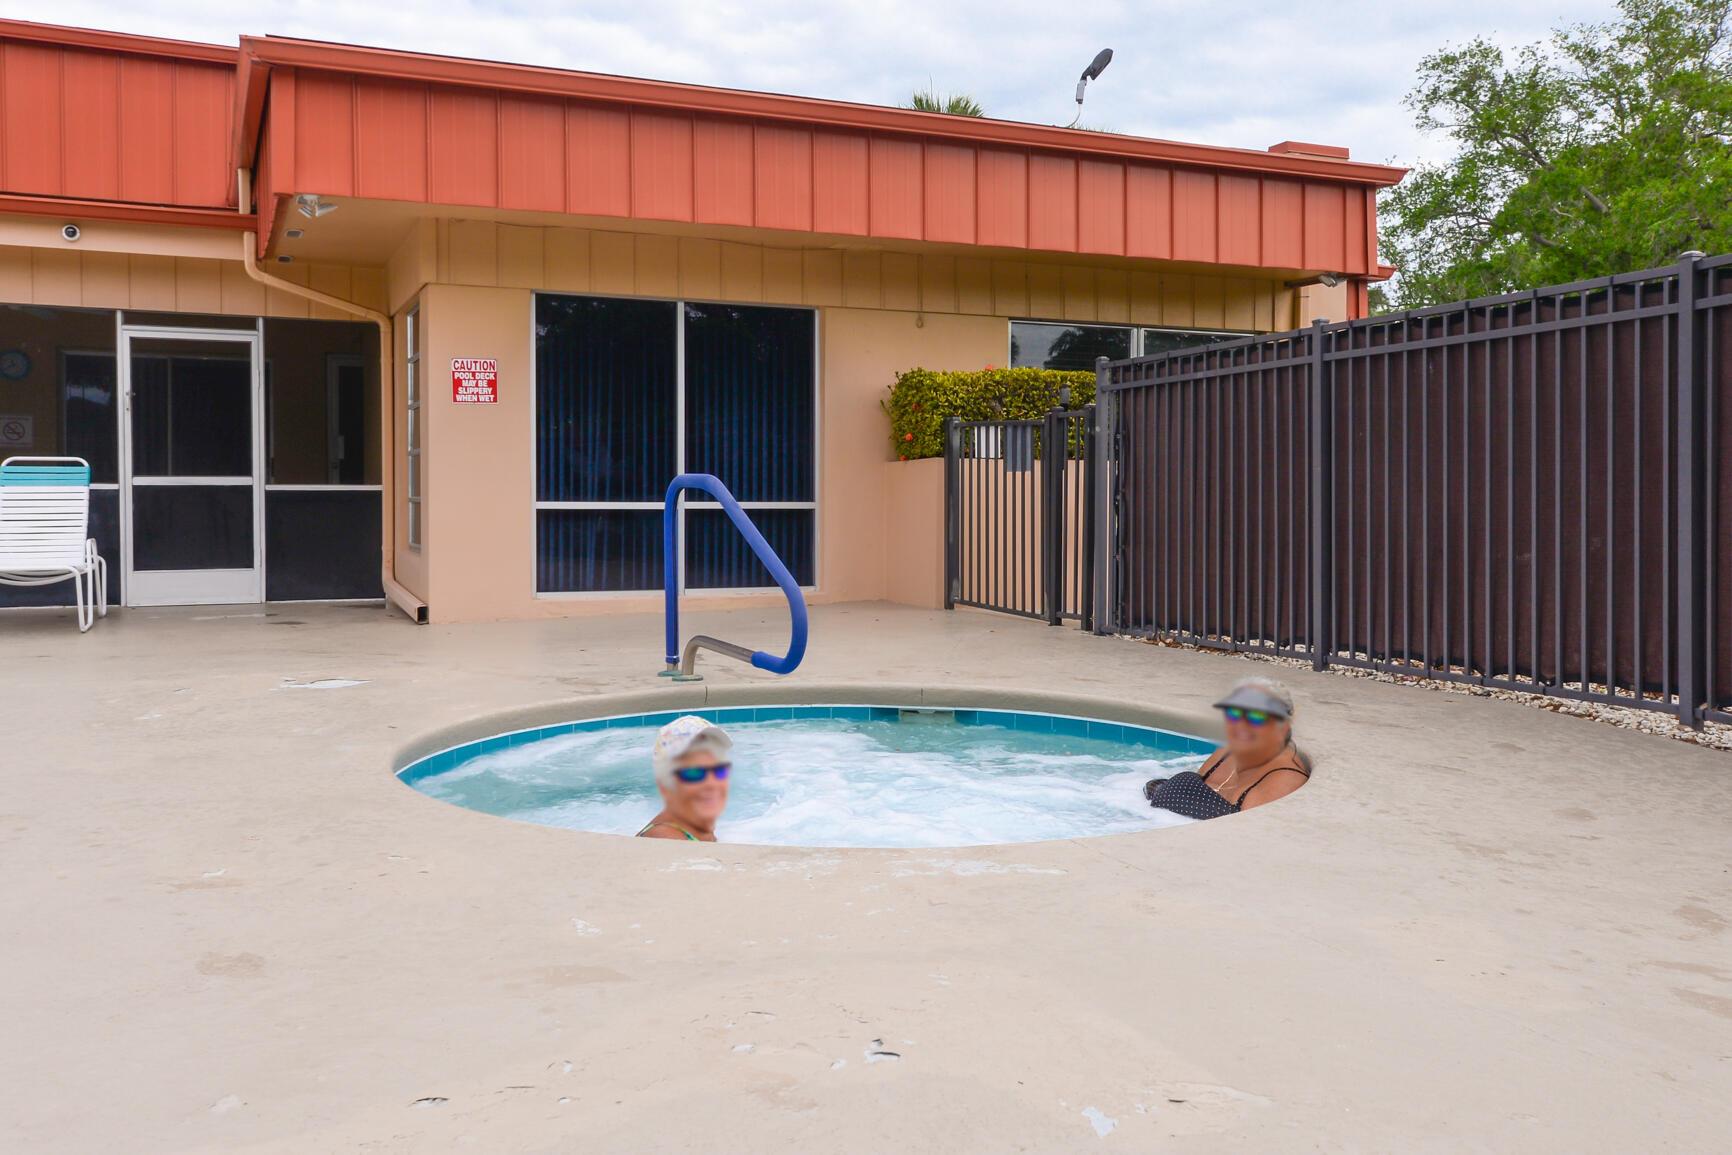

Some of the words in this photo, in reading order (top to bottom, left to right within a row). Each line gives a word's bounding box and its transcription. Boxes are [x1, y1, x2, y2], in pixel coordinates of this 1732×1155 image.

[453, 360, 496, 371] CAUTION
[456, 394, 478, 402] WHEN
[478, 394, 495, 402] WET
